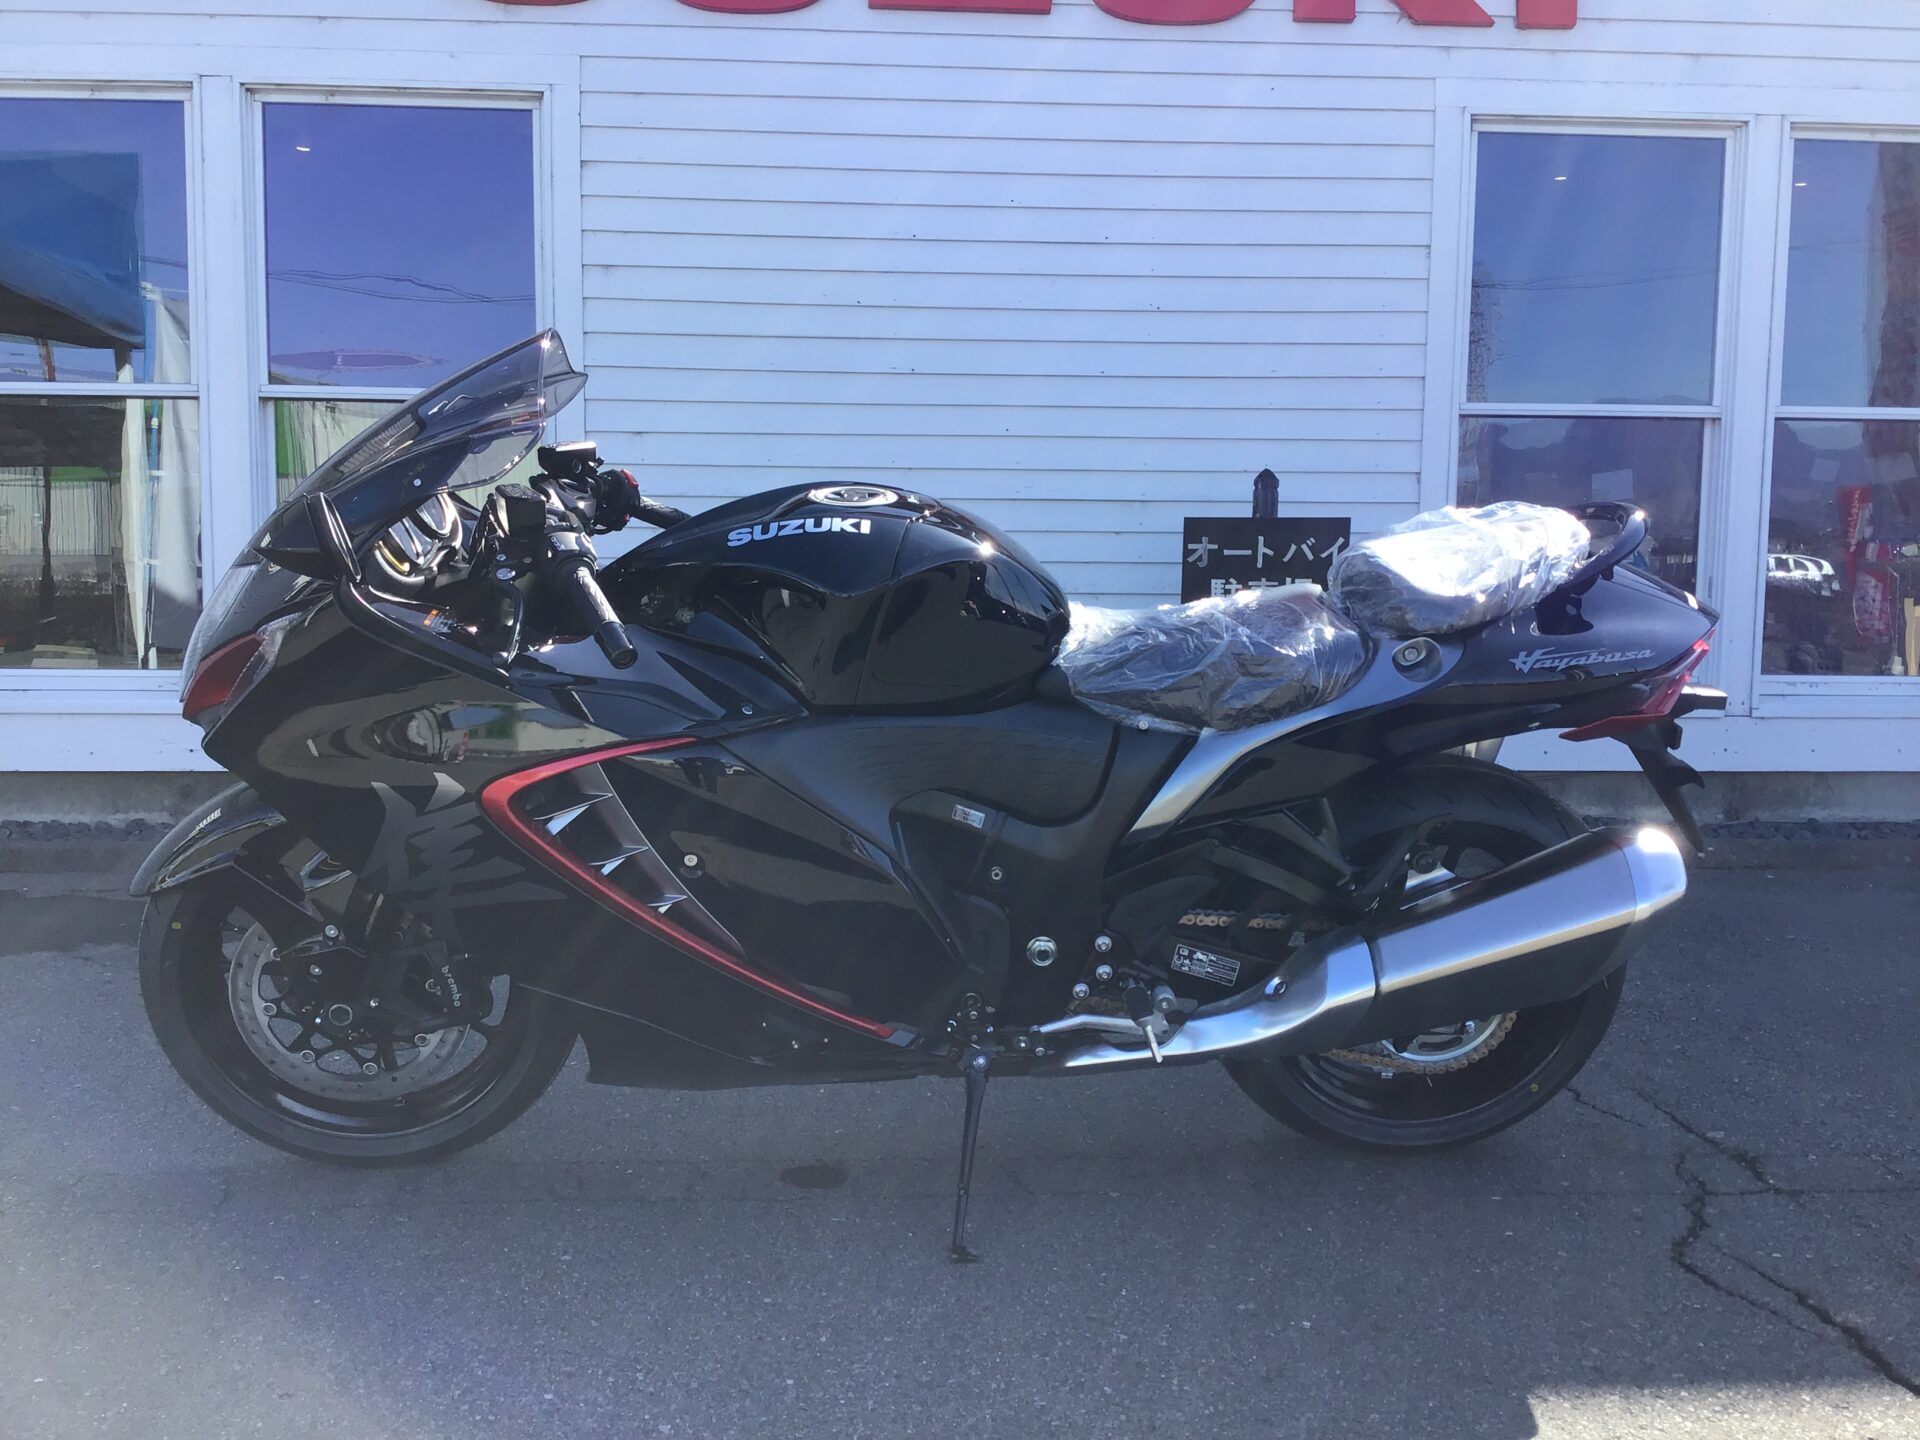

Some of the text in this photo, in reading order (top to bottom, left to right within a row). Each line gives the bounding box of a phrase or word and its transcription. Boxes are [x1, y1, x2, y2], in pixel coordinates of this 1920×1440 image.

[726, 517, 872, 548] SUZUKI
[1186, 535, 1346, 569] オートバイ
[1508, 647, 1656, 674] Hayabusa
[441, 964, 462, 1008] brembo
